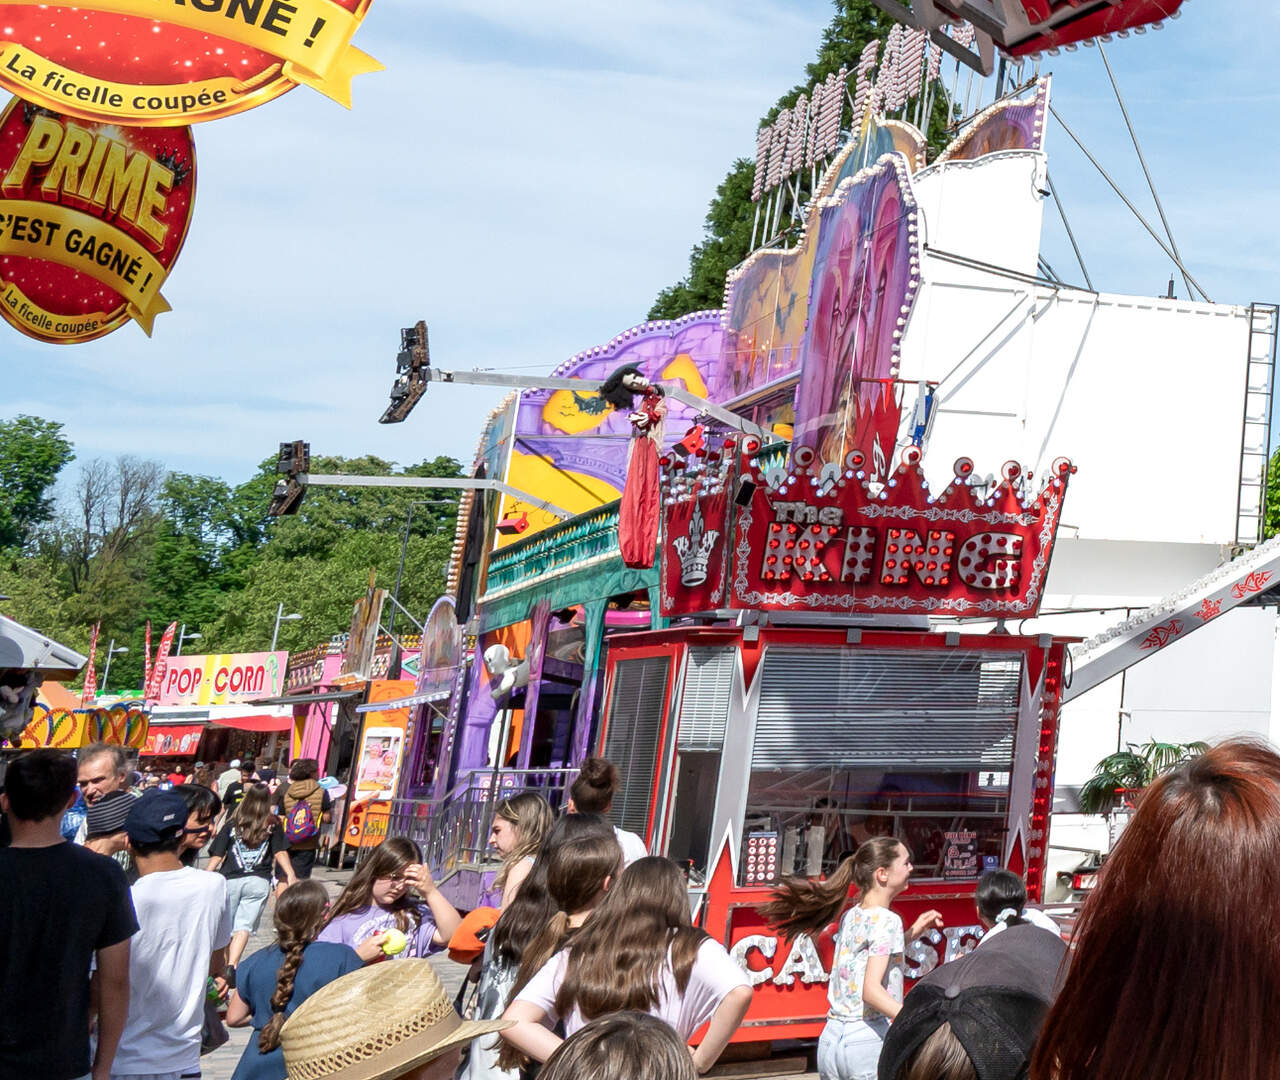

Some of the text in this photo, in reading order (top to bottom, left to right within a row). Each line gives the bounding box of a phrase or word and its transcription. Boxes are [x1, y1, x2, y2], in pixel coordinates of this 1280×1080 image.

[5, 53, 228, 113] La ficelle coupée
[1, 115, 175, 252] PRIME
[65, 228, 143, 286] GAGNÉ
[4, 290, 98, 335] La ficelle coupée
[772, 500, 845, 526] The
[760, 521, 1024, 590] KING
[166, 667, 202, 697] POP
[214, 664, 265, 696] CORN
